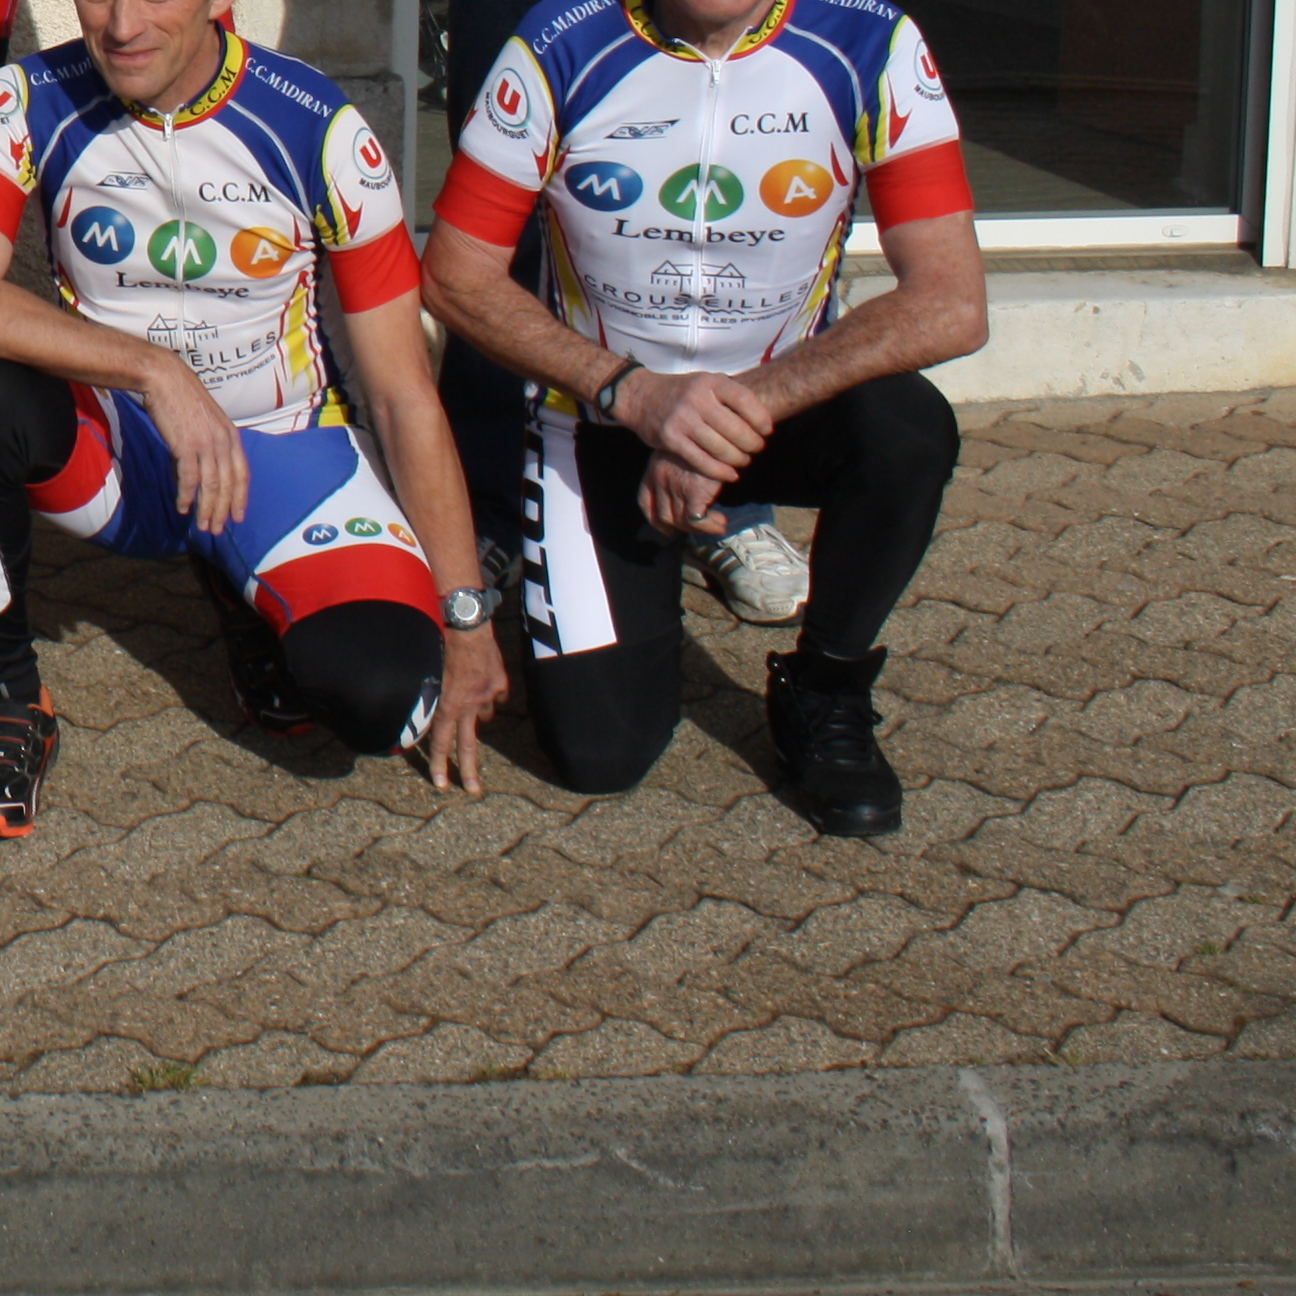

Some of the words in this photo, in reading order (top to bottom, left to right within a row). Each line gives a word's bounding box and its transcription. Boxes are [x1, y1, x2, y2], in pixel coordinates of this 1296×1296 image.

[188, 68, 237, 116] C.C.M
[245, 55, 333, 119] C.C.MADIRAN
[495, 78, 522, 116] U
[729, 111, 809, 135] C.C.M
[360, 137, 383, 168] U
[198, 180, 273, 203] C.C.M
[612, 218, 786, 245] Lembeye
[583, 272, 809, 309] CROUSEILLES
